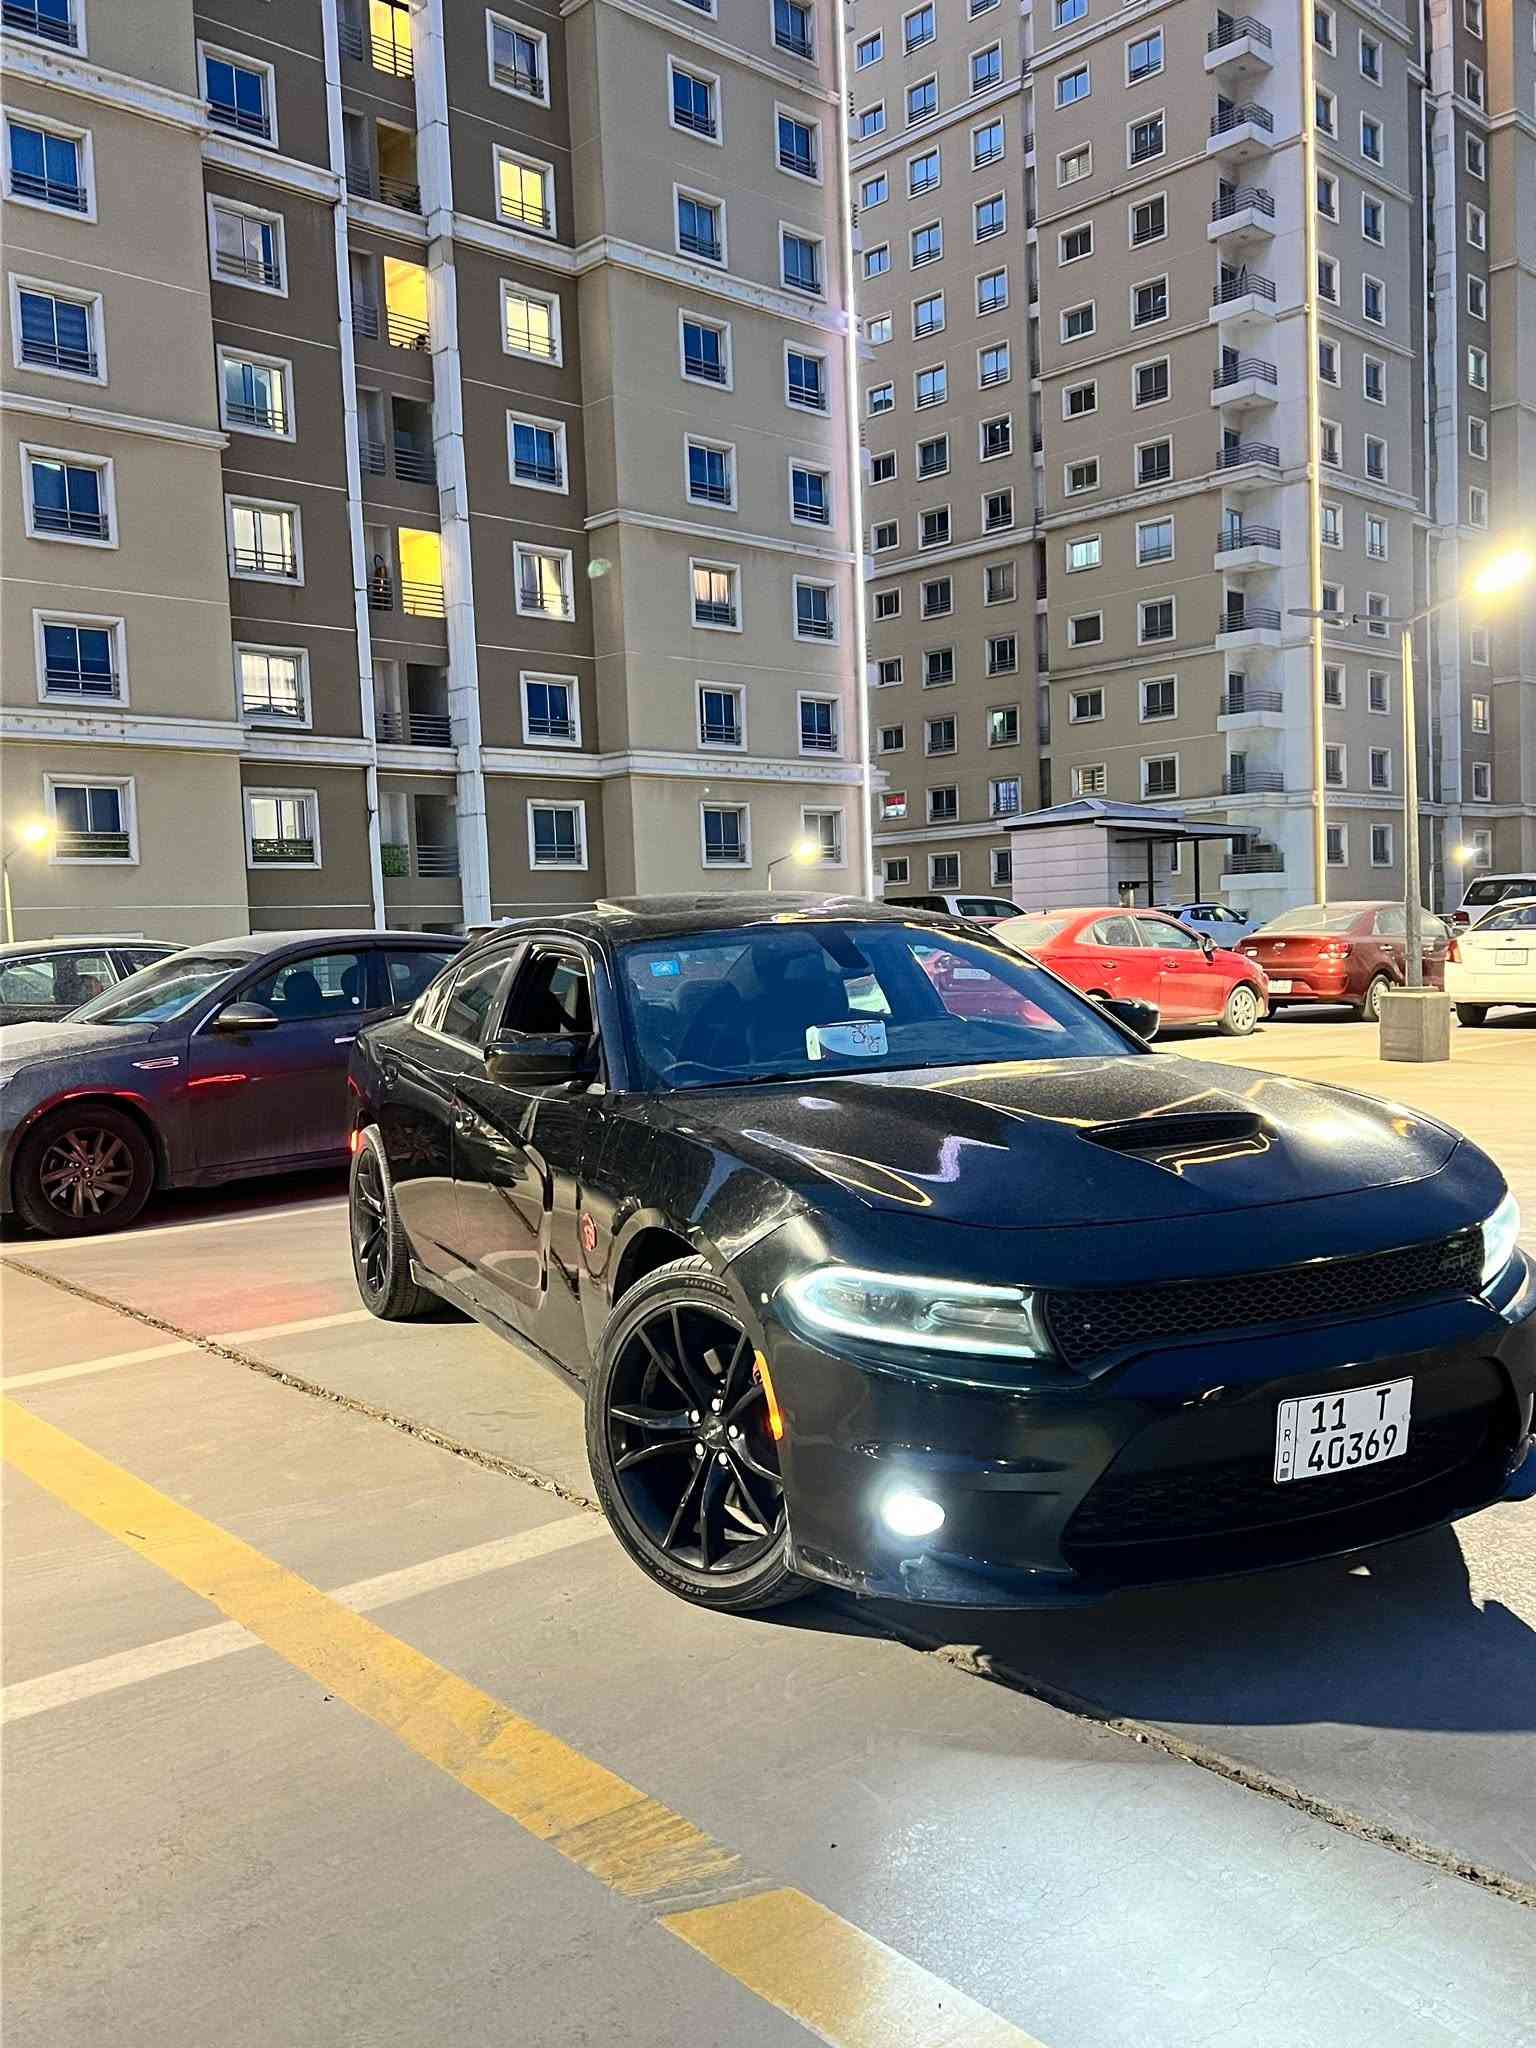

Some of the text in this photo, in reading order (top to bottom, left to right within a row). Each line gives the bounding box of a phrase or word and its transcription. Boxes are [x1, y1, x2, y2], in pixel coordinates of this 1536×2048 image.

[1310, 1388, 1391, 1434] 11 T
[1308, 1424, 1397, 1471] 40369
